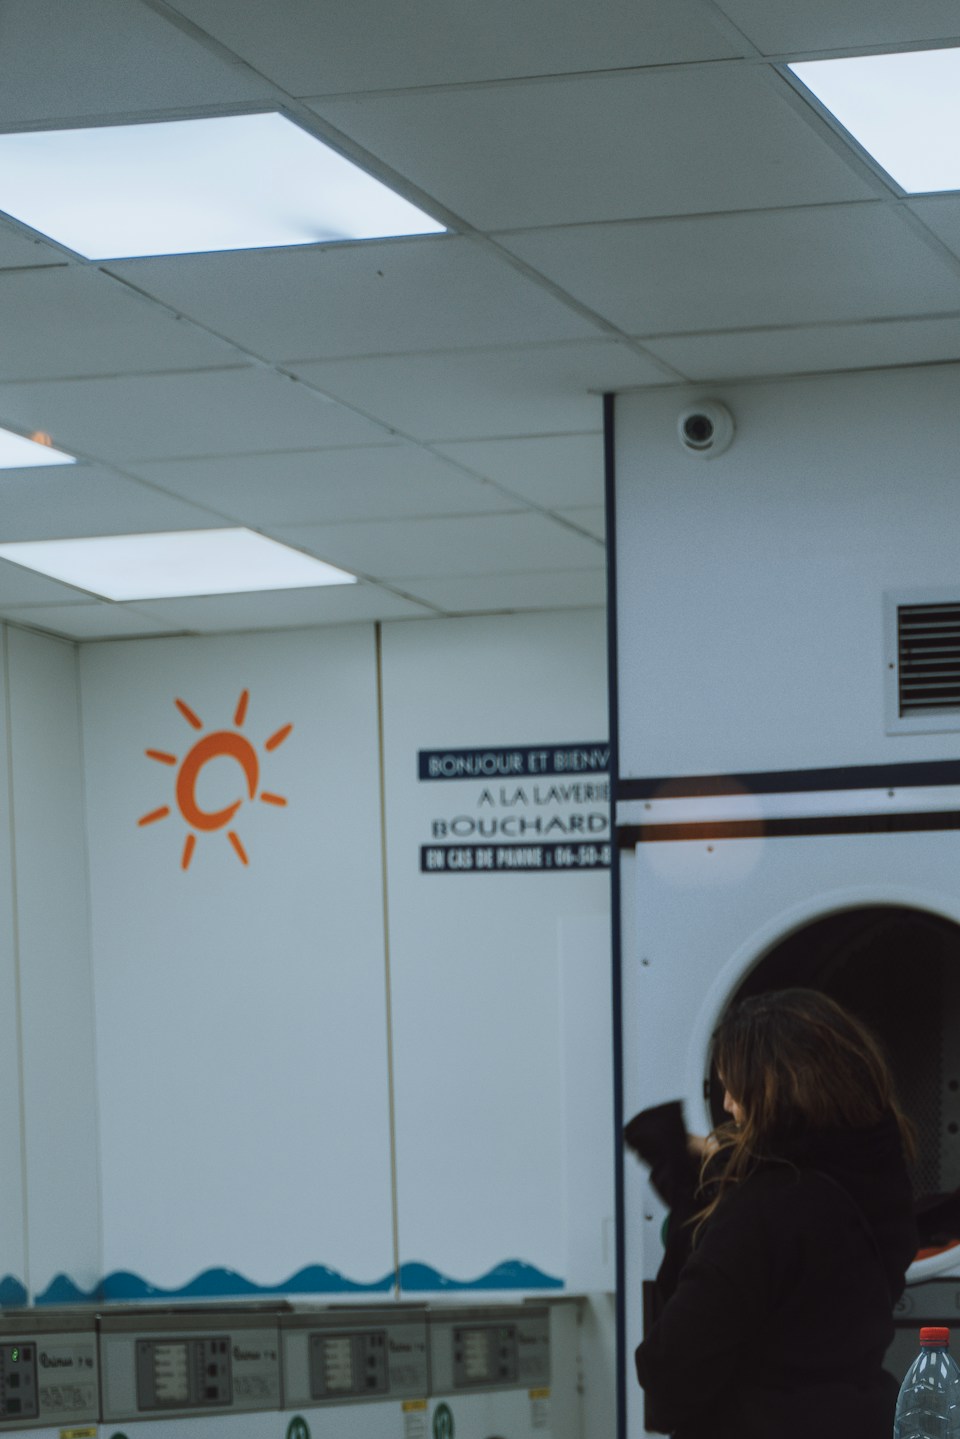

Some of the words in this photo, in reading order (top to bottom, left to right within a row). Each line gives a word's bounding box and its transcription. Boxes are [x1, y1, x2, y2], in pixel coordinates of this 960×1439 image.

[429, 752, 523, 776] BONJOUR
[528, 752, 548, 771] ET
[478, 787, 495, 807] A
[500, 786, 529, 807] LA
[426, 849, 444, 869] EN
[447, 848, 473, 869] CAS
[476, 848, 493, 868] DE
